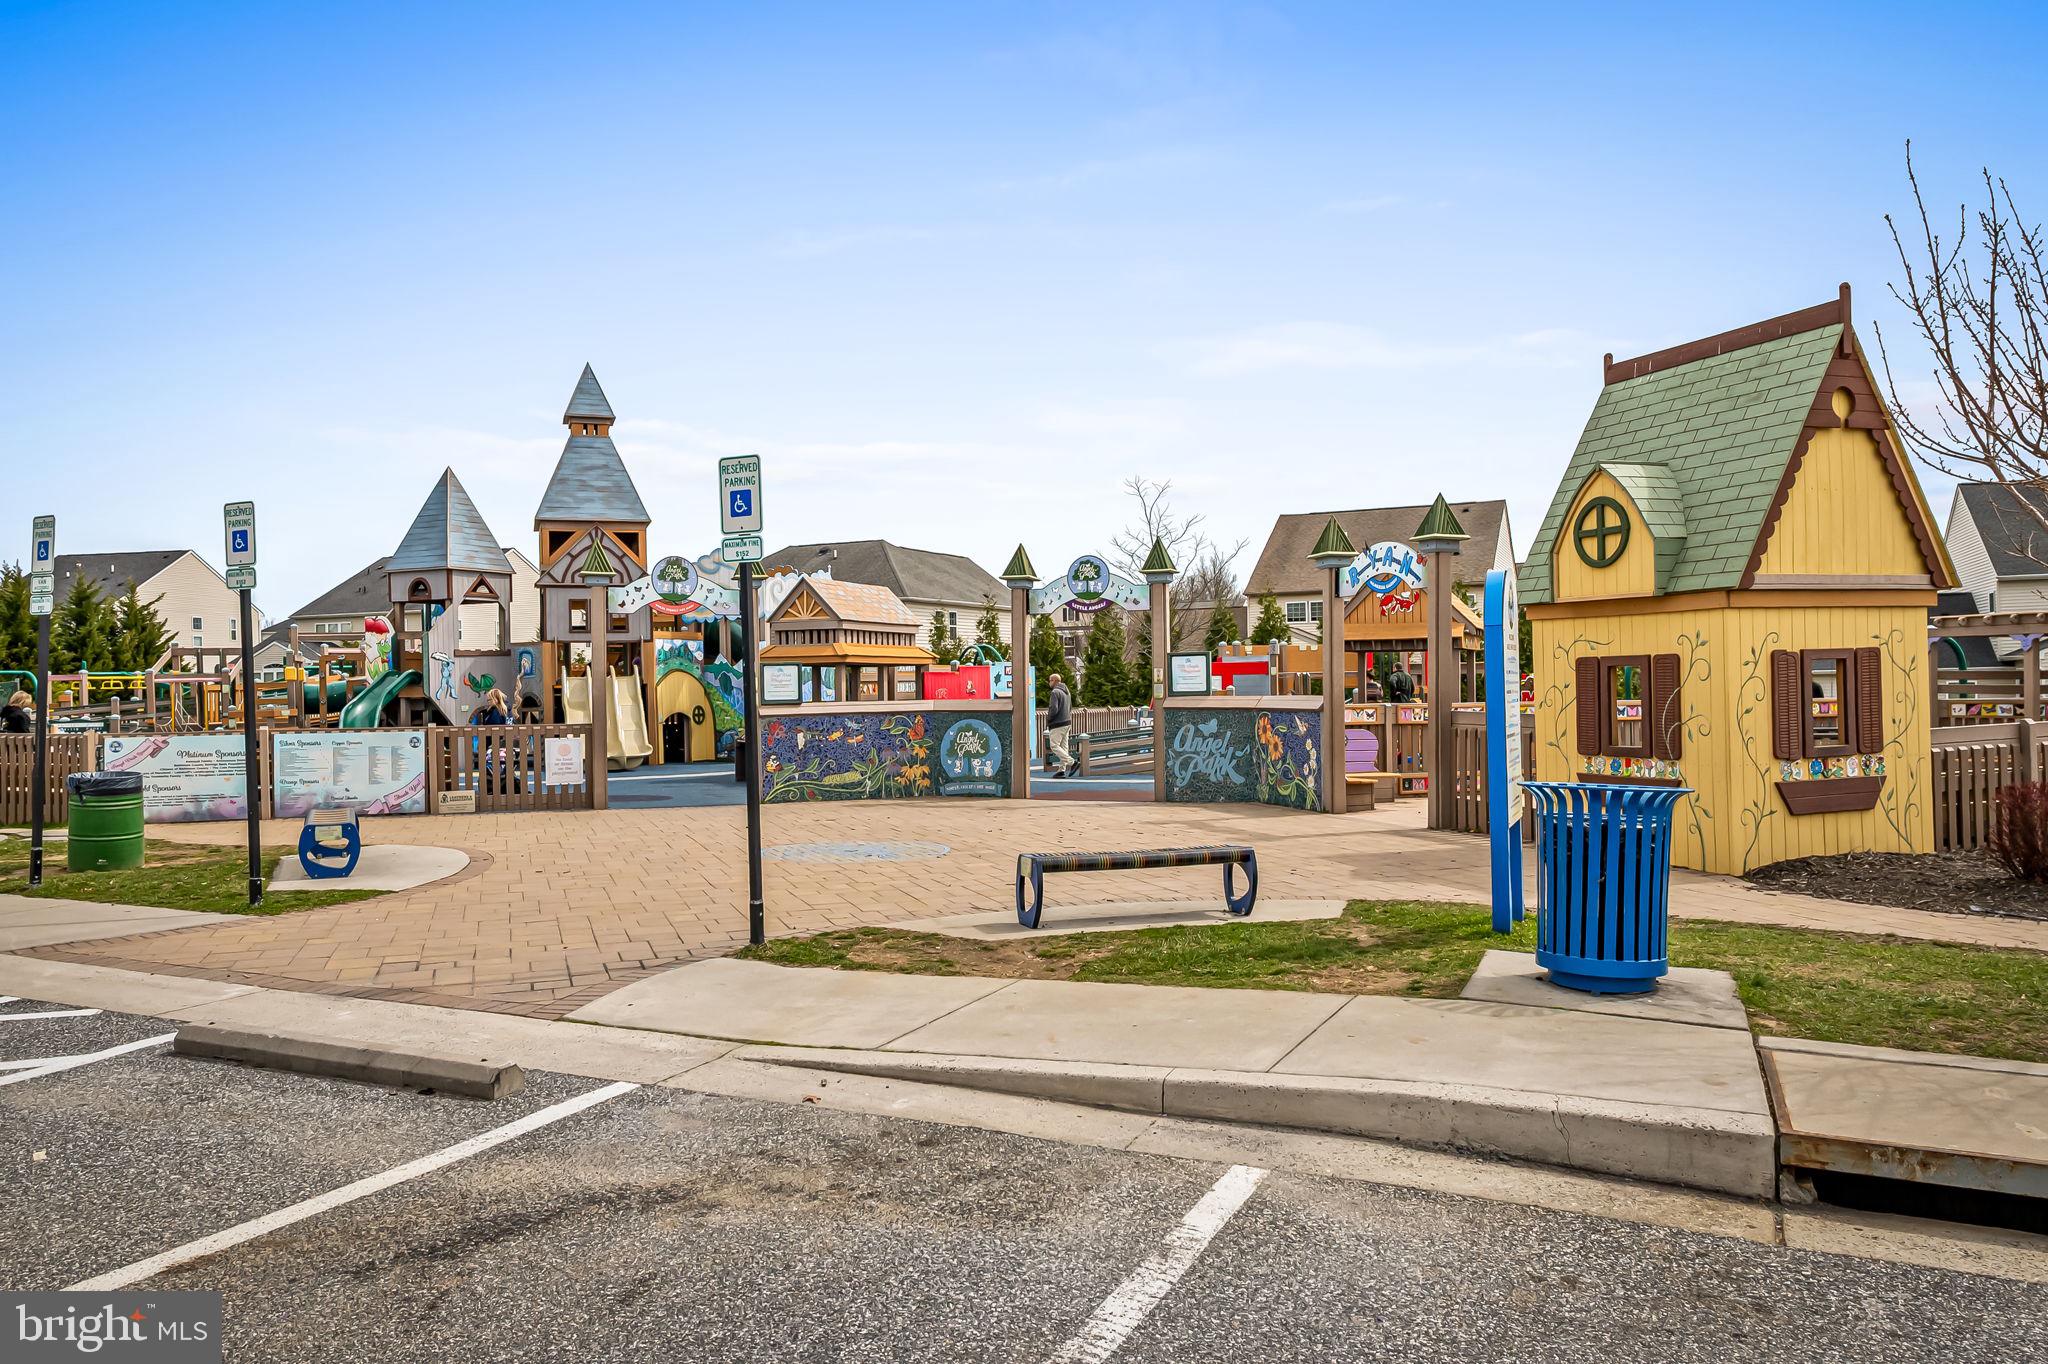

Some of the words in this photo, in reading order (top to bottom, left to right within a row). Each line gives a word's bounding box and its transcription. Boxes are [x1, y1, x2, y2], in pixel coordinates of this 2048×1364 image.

[721, 462, 758, 475] RESERVED
[724, 476, 756, 488] PARKING
[225, 507, 253, 517] RESERVED
[227, 519, 252, 528] PARKING
[724, 540, 748, 548] MAXIMUM
[748, 539, 760, 547] FINE
[735, 550, 750, 558] $152
[1348, 546, 1413, 588] RYAN
[1071, 602, 1088, 611] LITTLE
[297, 740, 322, 748] Sponsors
[957, 731, 979, 747] Angel
[1173, 723, 1232, 759] Angel
[176, 749, 214, 760] Platinum
[957, 742, 986, 757] Park
[1173, 746, 1246, 787] Park
[151, 783, 182, 793] Sponsors
